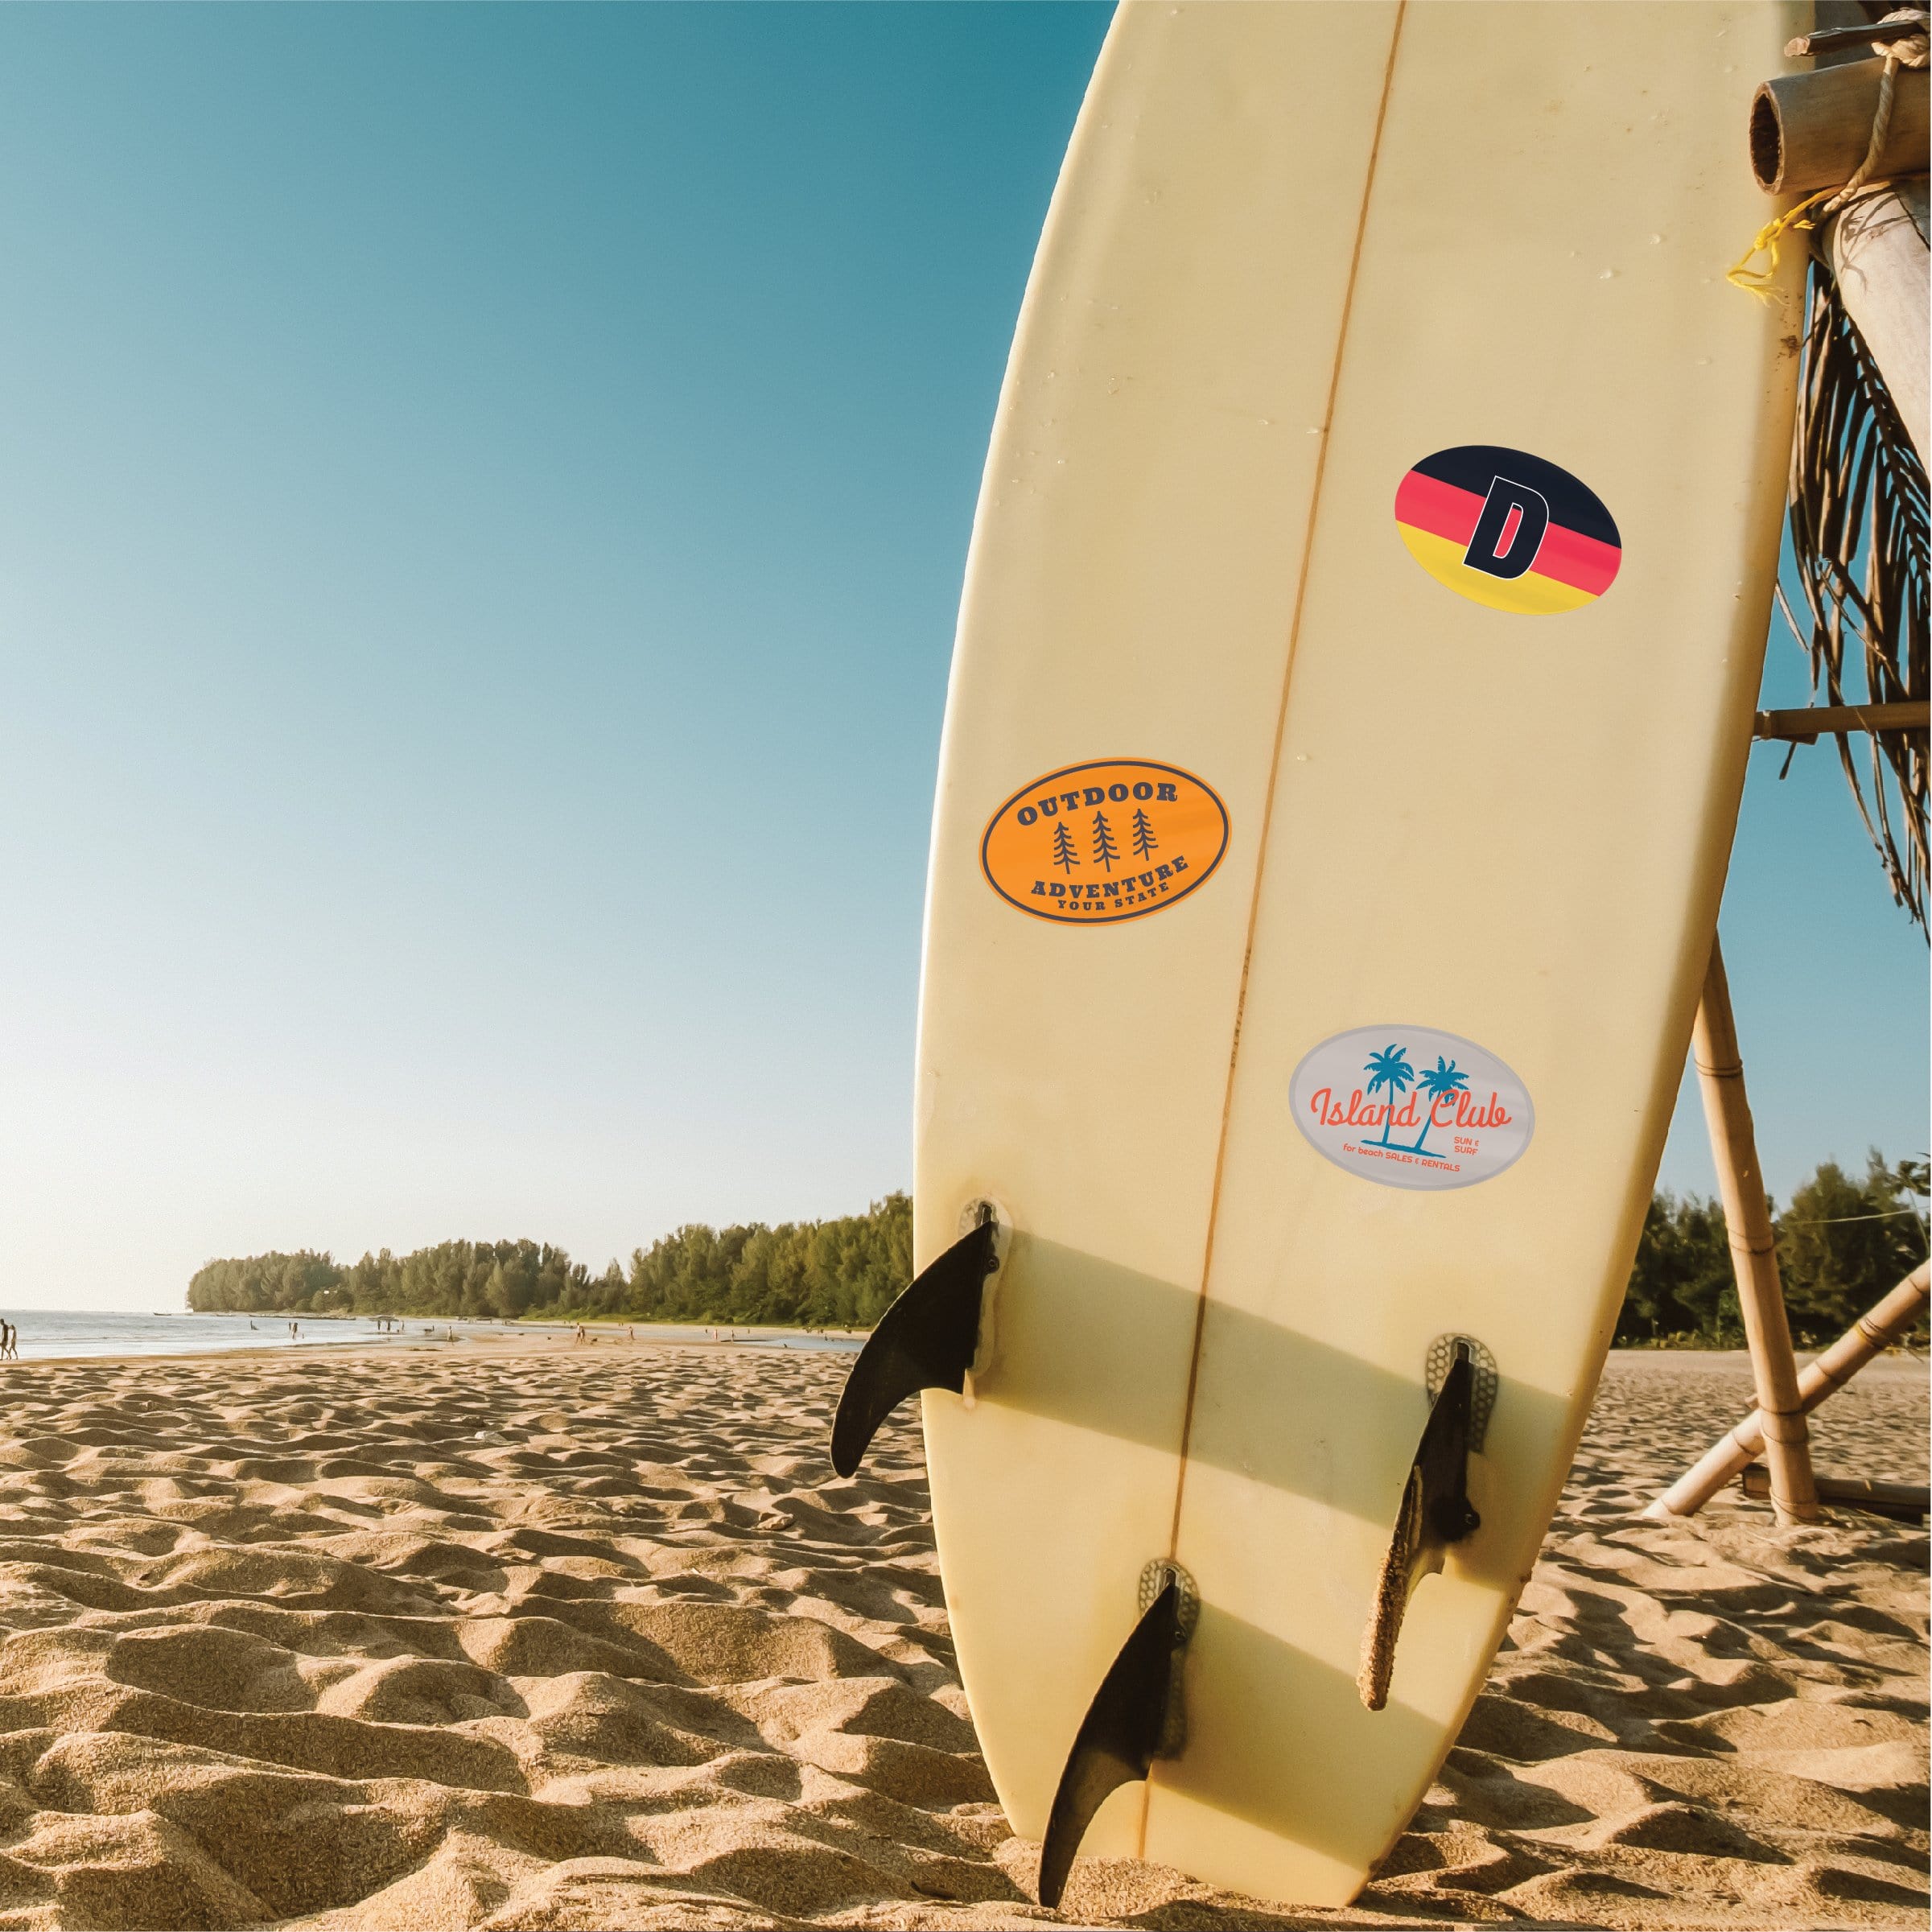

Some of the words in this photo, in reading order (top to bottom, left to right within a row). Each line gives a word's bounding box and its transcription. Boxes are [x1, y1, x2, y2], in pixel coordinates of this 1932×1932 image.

[1462, 476, 1550, 580] D
[1016, 781, 1178, 826] OUTDOOR
[1031, 855, 1189, 899] ADVENTURE
[1057, 899, 1106, 911] YOUR
[1114, 882, 1170, 908] STATE
[1310, 1087, 1422, 1128] Island
[1431, 1088, 1513, 1128] Club
[1342, 1143, 1356, 1153] for
[1357, 1146, 1383, 1160] beach
[1385, 1151, 1413, 1164] SALES
[1421, 1159, 1461, 1172] RENTALS
[1453, 1136, 1473, 1147] SUN
[1454, 1145, 1479, 1156] SURF
